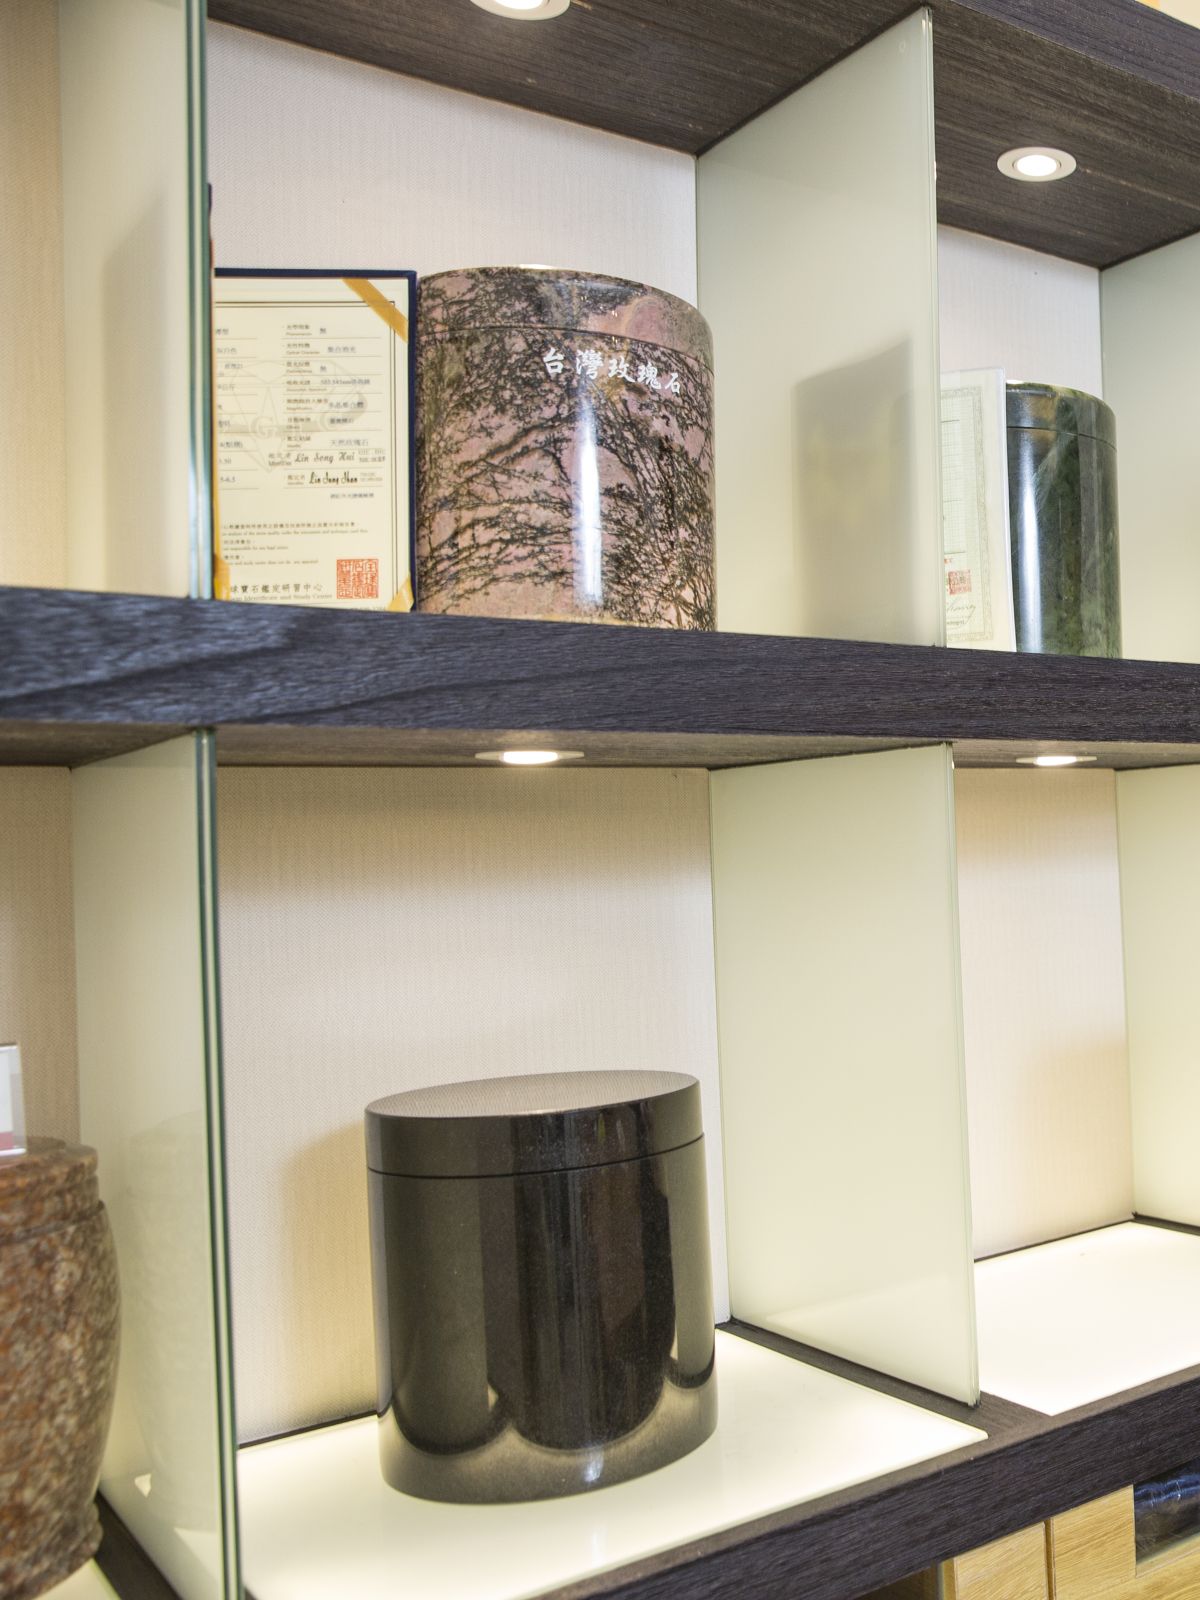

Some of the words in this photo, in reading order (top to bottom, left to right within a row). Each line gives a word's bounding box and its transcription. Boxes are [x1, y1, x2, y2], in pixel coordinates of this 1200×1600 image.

[543, 347, 681, 394] 台灣玫瑰石
